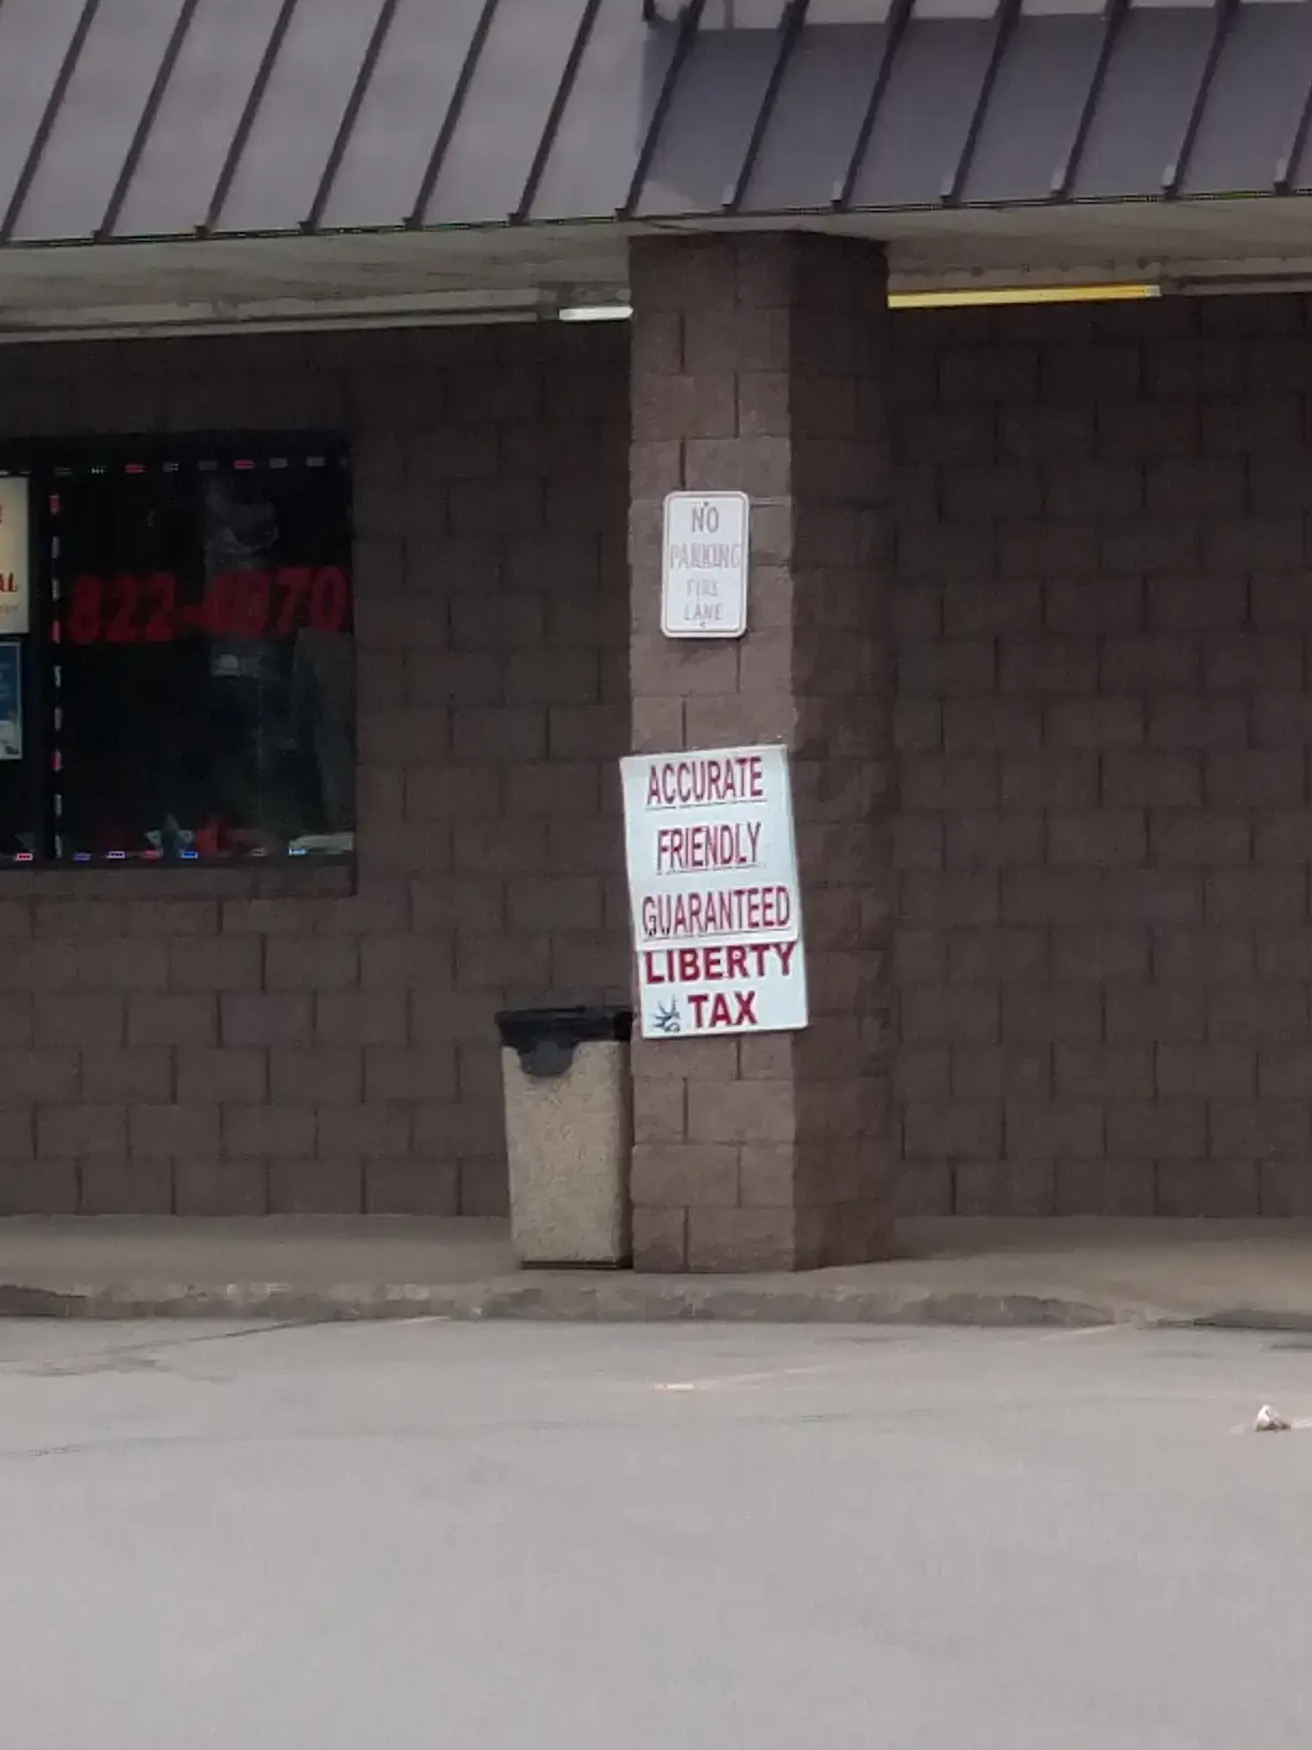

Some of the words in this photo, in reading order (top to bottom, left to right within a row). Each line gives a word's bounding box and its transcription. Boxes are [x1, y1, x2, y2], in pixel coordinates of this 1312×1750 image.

[690, 506, 720, 533] NO
[670, 543, 741, 570] PARKING
[686, 579, 720, 597] FIRE
[683, 603, 723, 621] LANE
[646, 756, 763, 805] ACCURATE
[656, 821, 761, 872] FRIENDLY
[641, 886, 791, 937] GUARANTEED
[643, 942, 798, 984] LIBERTY
[688, 991, 758, 1028] TAX
